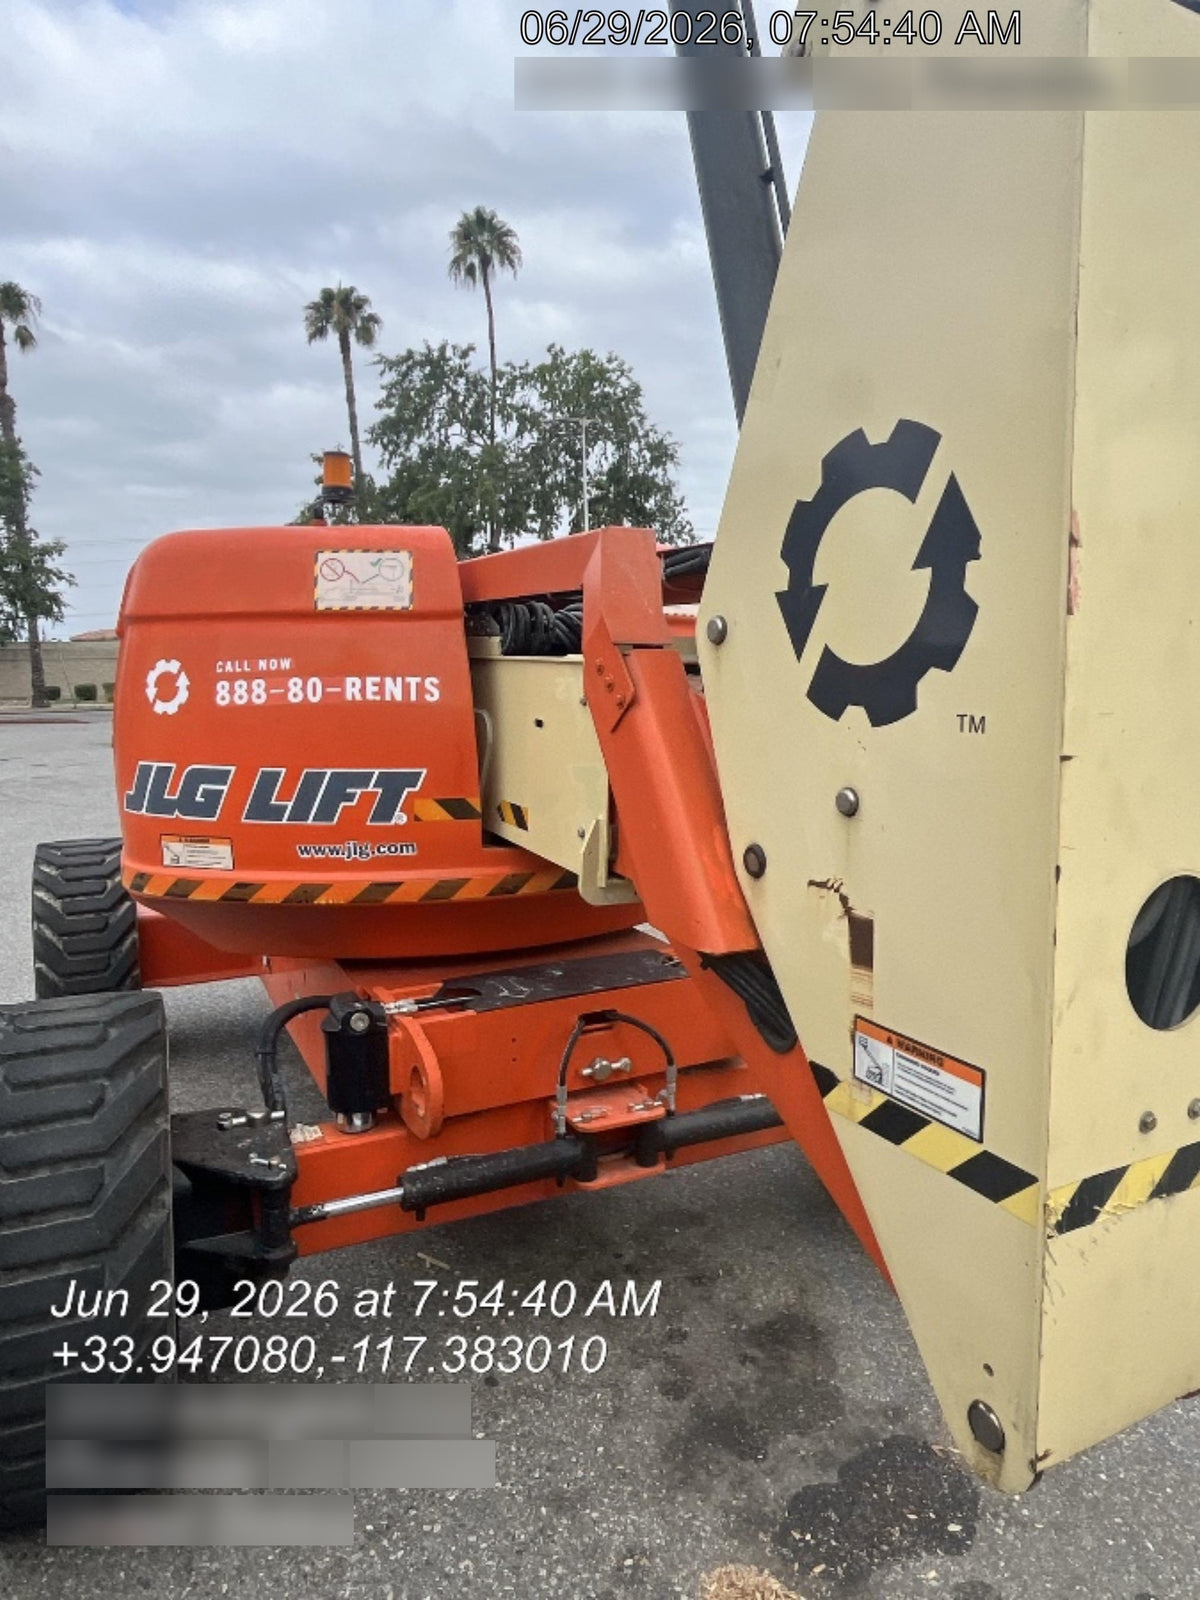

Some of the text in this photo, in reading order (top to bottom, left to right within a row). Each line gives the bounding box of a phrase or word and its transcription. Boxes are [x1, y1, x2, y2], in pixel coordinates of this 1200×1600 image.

[215, 657, 292, 673] CALL NOW
[215, 676, 441, 706] 888-80-RENTS
[956, 714, 986, 734] TM
[124, 761, 236, 821] JLG
[297, 841, 418, 861] www.jlg.com
